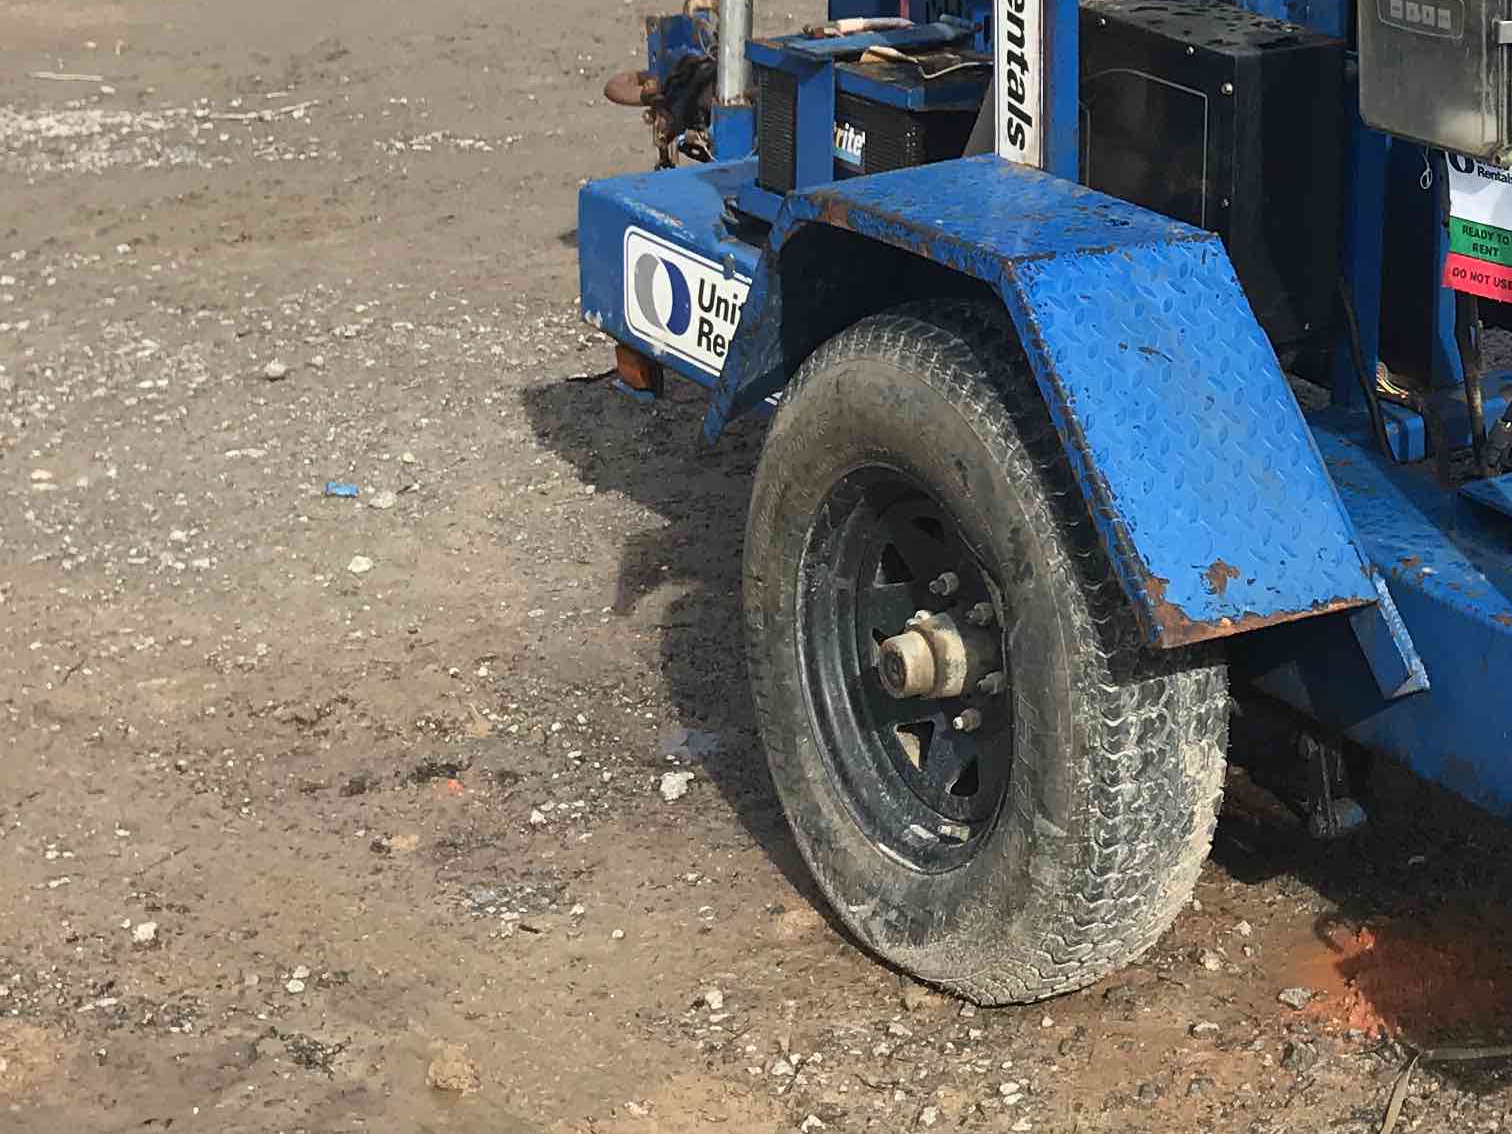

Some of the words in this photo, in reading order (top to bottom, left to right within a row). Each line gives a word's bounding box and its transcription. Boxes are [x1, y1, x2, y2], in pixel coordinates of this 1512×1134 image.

[833, 121, 866, 156] rite
[1462, 224, 1495, 241] READY
[1496, 233, 1510, 246] TO
[1472, 242, 1501, 257] RENT
[1452, 266, 1467, 279] DO
[1470, 271, 1491, 285] NOT
[698, 277, 741, 325] Uni
